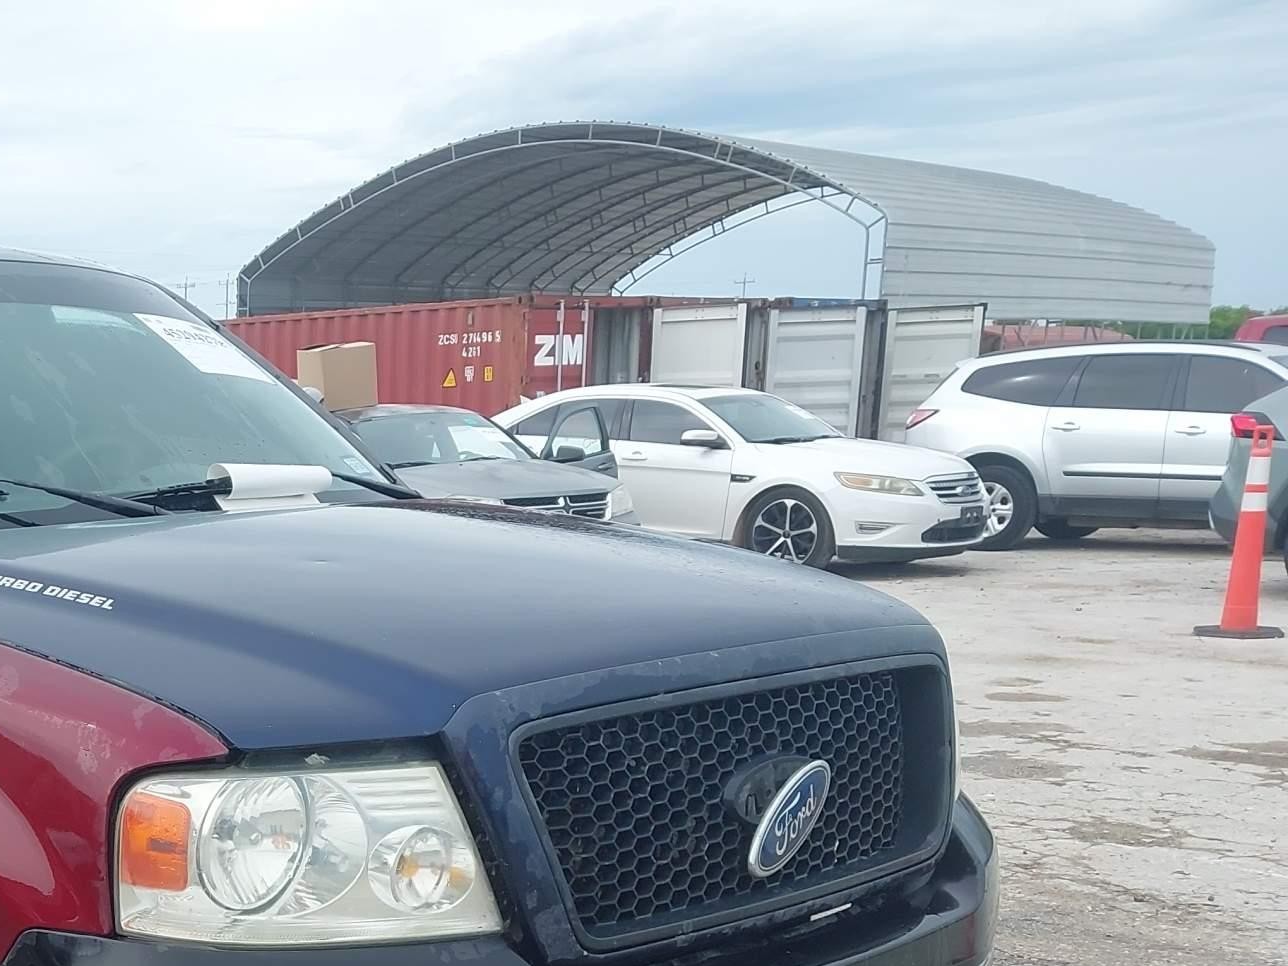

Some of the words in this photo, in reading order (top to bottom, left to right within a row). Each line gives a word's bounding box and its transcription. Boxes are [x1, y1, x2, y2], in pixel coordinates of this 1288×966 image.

[534, 334, 583, 366] ZIM
[42, 585, 115, 610] DIESEL
[775, 783, 816, 856] Ford
